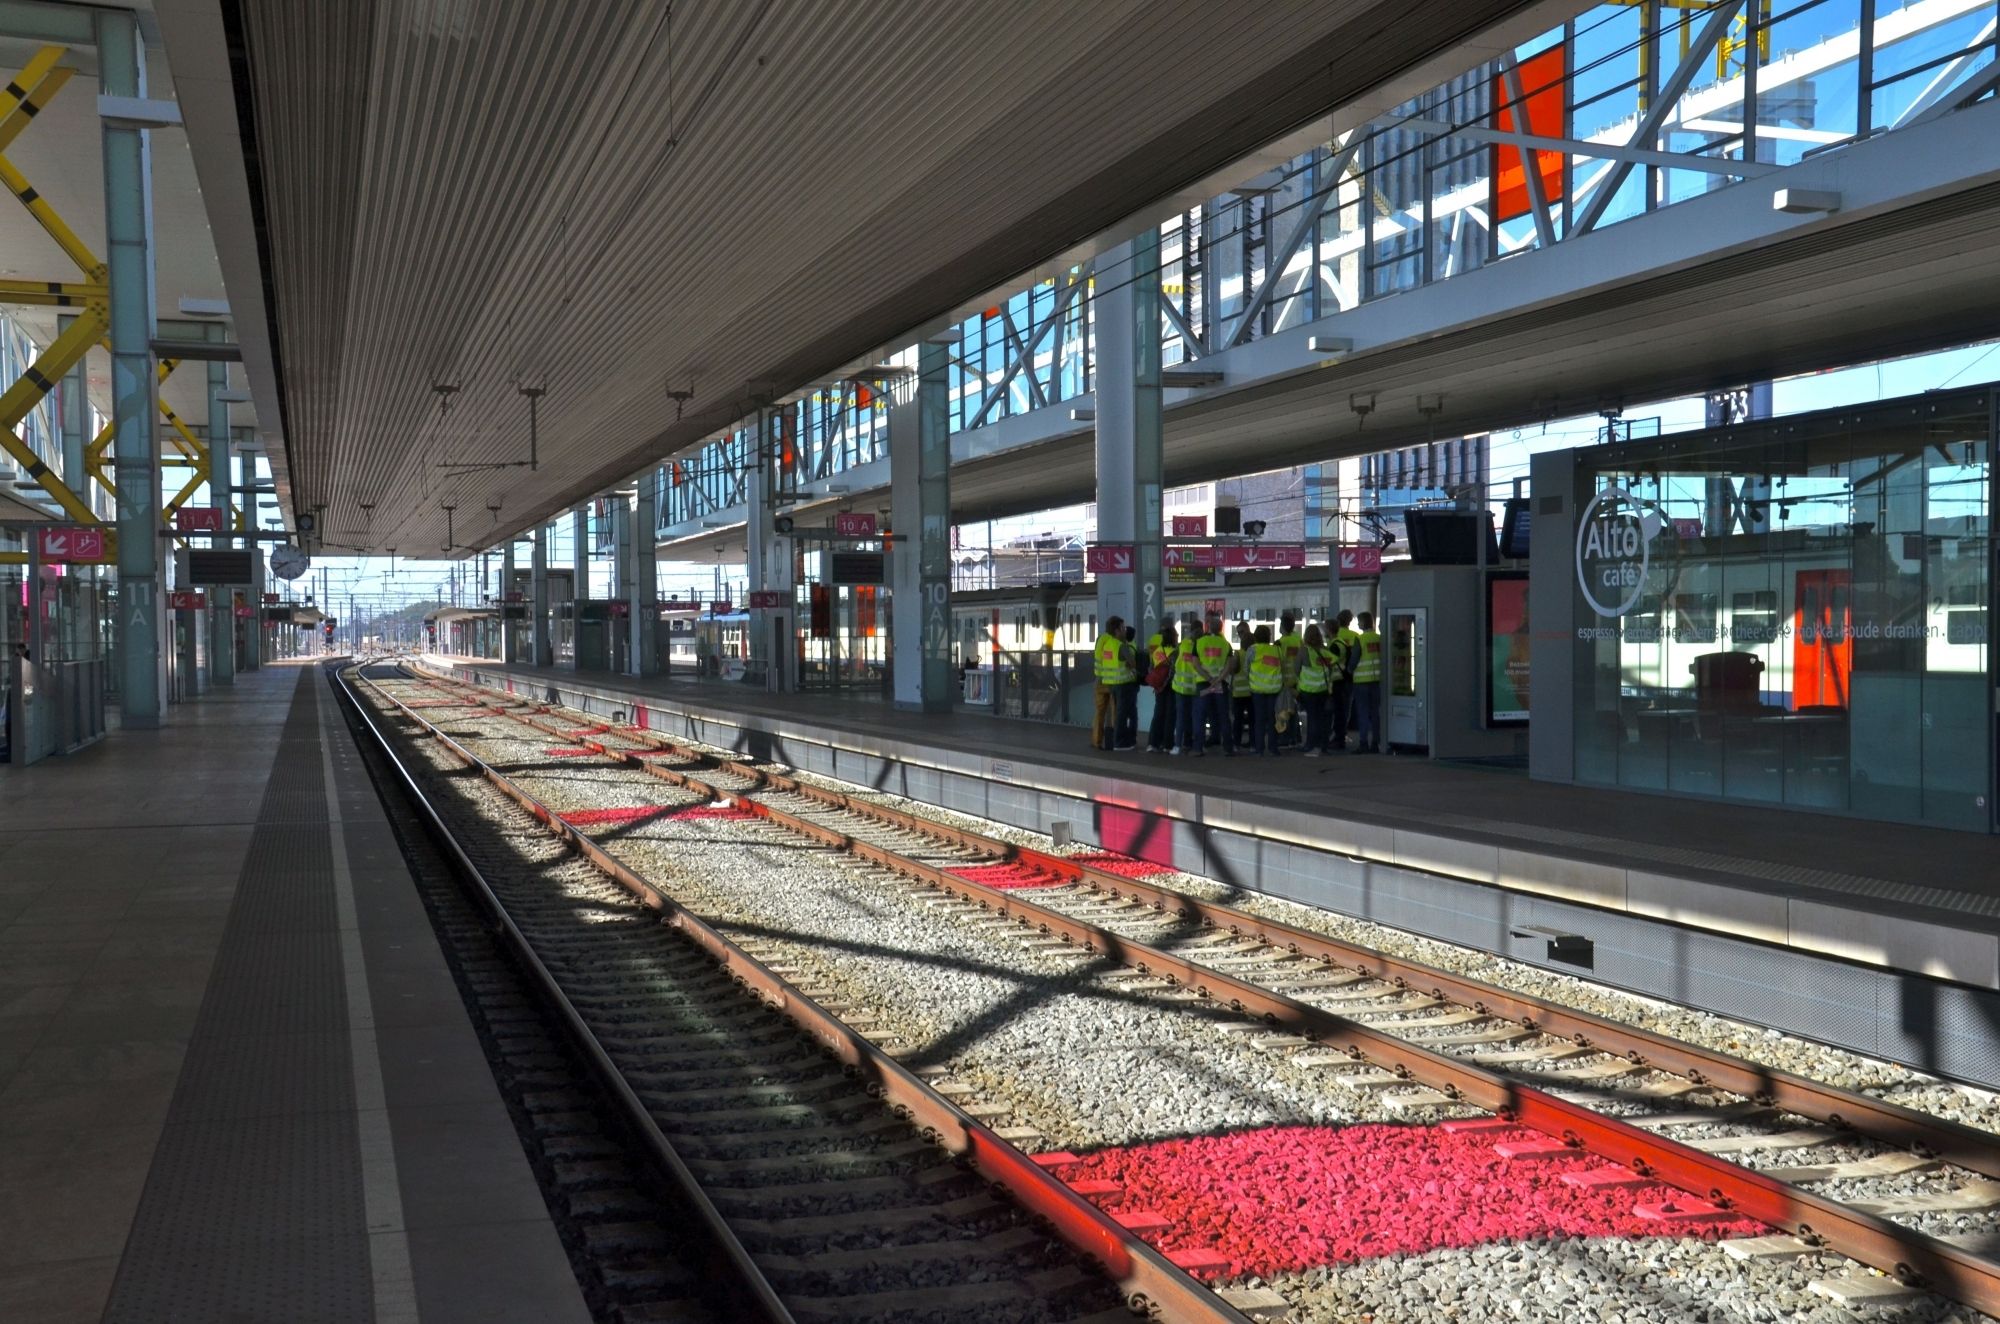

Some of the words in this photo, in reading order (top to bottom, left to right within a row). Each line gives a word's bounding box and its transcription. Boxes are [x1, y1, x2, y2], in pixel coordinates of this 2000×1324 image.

[183, 516, 195, 526] 11
[205, 516, 215, 526] A
[842, 522, 854, 530] 10
[861, 522, 869, 530] A
[1179, 523, 1185, 532] 9
[1194, 523, 1202, 532] A
[1584, 520, 1637, 559] Alto
[1602, 561, 1636, 587] café
[127, 582, 150, 606] 11
[925, 582, 946, 604] 10
[1144, 583, 1154, 602] 9
[641, 607, 654, 621] 10
[930, 607, 942, 621] A
[1144, 606, 1156, 620] A
[1933, 596, 1942, 615] 2
[130, 608, 147, 626] A
[1578, 626, 1614, 643] espresso
[1736, 624, 1759, 639] thee
[1767, 623, 1791, 640] café
[1838, 620, 1879, 638] koude
[1884, 620, 1939, 638] dranken
